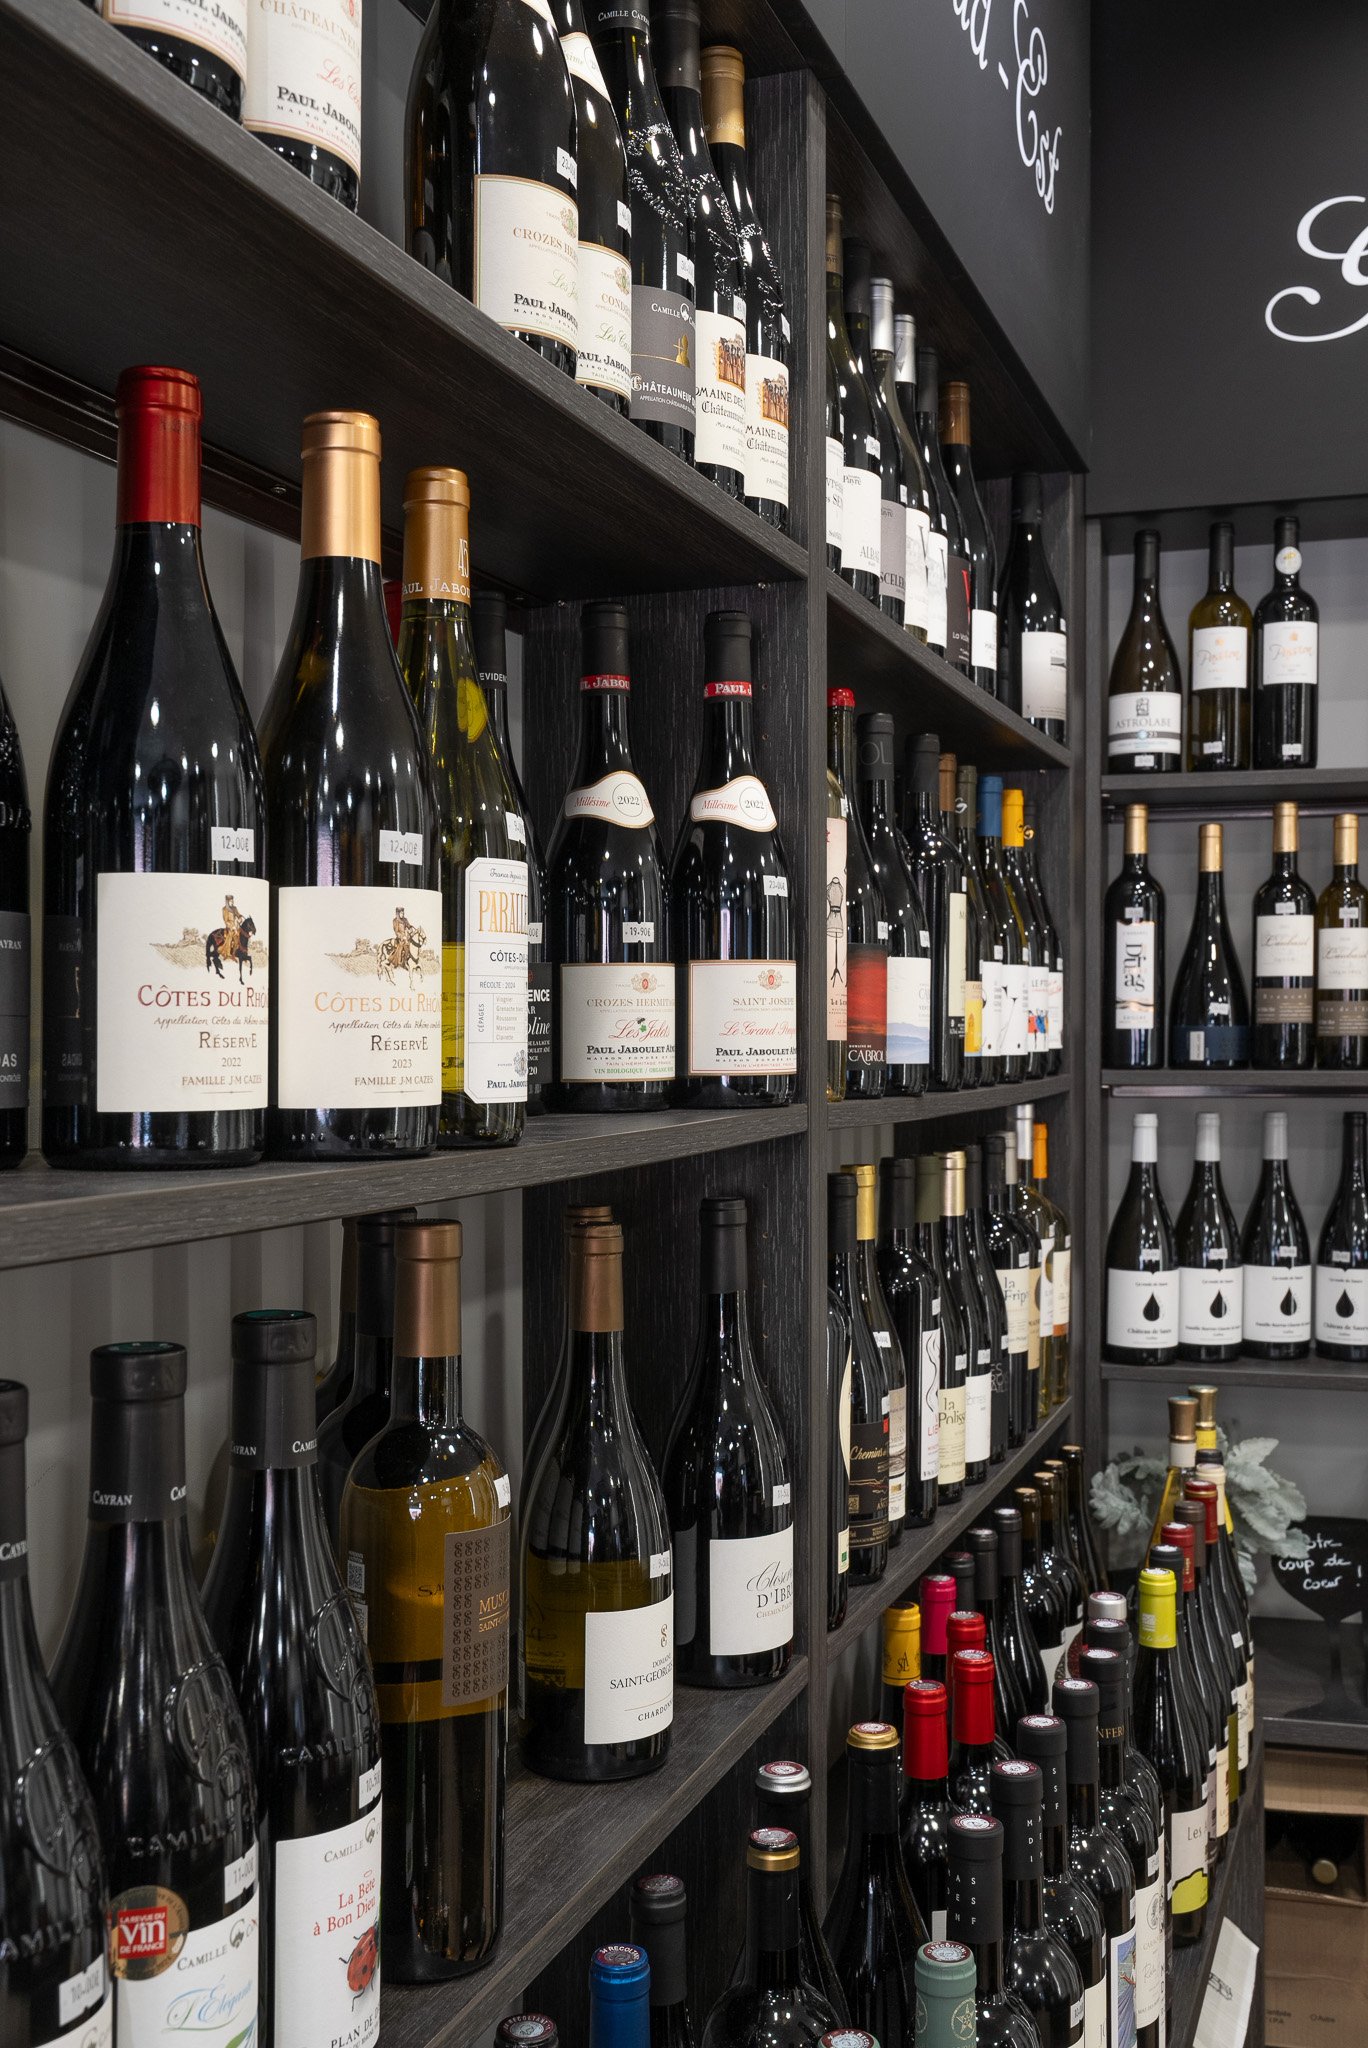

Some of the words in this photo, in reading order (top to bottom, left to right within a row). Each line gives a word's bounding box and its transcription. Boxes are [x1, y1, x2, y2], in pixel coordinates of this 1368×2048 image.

[597, 9, 629, 22] CAMILLE
[276, 85, 319, 111] PAUL
[513, 227, 563, 250] CROZES
[514, 293, 546, 311] PAUL
[651, 302, 681, 319] CAMILLE
[715, 683, 746, 694] PAUL
[575, 797, 611, 808] Millésime
[618, 796, 640, 806] 2022
[702, 800, 738, 811] Millésime
[745, 800, 765, 809] 2022
[138, 985, 211, 1007] CÔTES
[219, 991, 241, 1007] DU
[315, 992, 383, 1012] CÔTES
[389, 997, 412, 1012] DU
[587, 998, 633, 1007] CROZES
[733, 997, 767, 1006] SAINT
[154, 1014, 208, 1030] Appellation
[212, 1016, 231, 1025] Côtes
[477, 1003, 485, 1033] CÉPAGES
[328, 1020, 380, 1033] Appellation
[382, 1020, 401, 1029] Côtes
[608, 1019, 640, 1039] Les
[720, 1021, 740, 1036] Le
[742, 1021, 778, 1037] Grand
[198, 1031, 257, 1048] RÉSERVE
[371, 1034, 428, 1050] RÉSERVE
[587, 1045, 615, 1054] PAUL
[617, 1045, 665, 1054] JABOULET
[716, 1048, 743, 1056] PAUL
[746, 1047, 789, 1056] JABOULET
[222, 1057, 241, 1067] 2022
[391, 1058, 412, 1069] 2023
[607, 1067, 642, 1075] BIOLOGIQUE
[182, 1076, 226, 1086] FAMILLE
[244, 1075, 262, 1084] CAZES
[355, 1077, 396, 1086] FAMILLE
[414, 1076, 434, 1085] CAZES
[487, 1080, 508, 1089] PAUL
[93, 1490, 133, 1506] CAYRAN
[324, 1840, 363, 1863] CAMILLE
[338, 1892, 354, 1910] La
[130, 1914, 152, 1923] REVUE
[154, 1912, 166, 1920] DU
[313, 1921, 321, 1937] à
[327, 1913, 353, 1933] Bon
[356, 1896, 377, 1920] Dieu
[119, 1919, 166, 1946] vin
[120, 1945, 131, 1954] DE
[132, 1941, 165, 1953] FRANCE
[177, 1943, 230, 1971] CAMILLE
